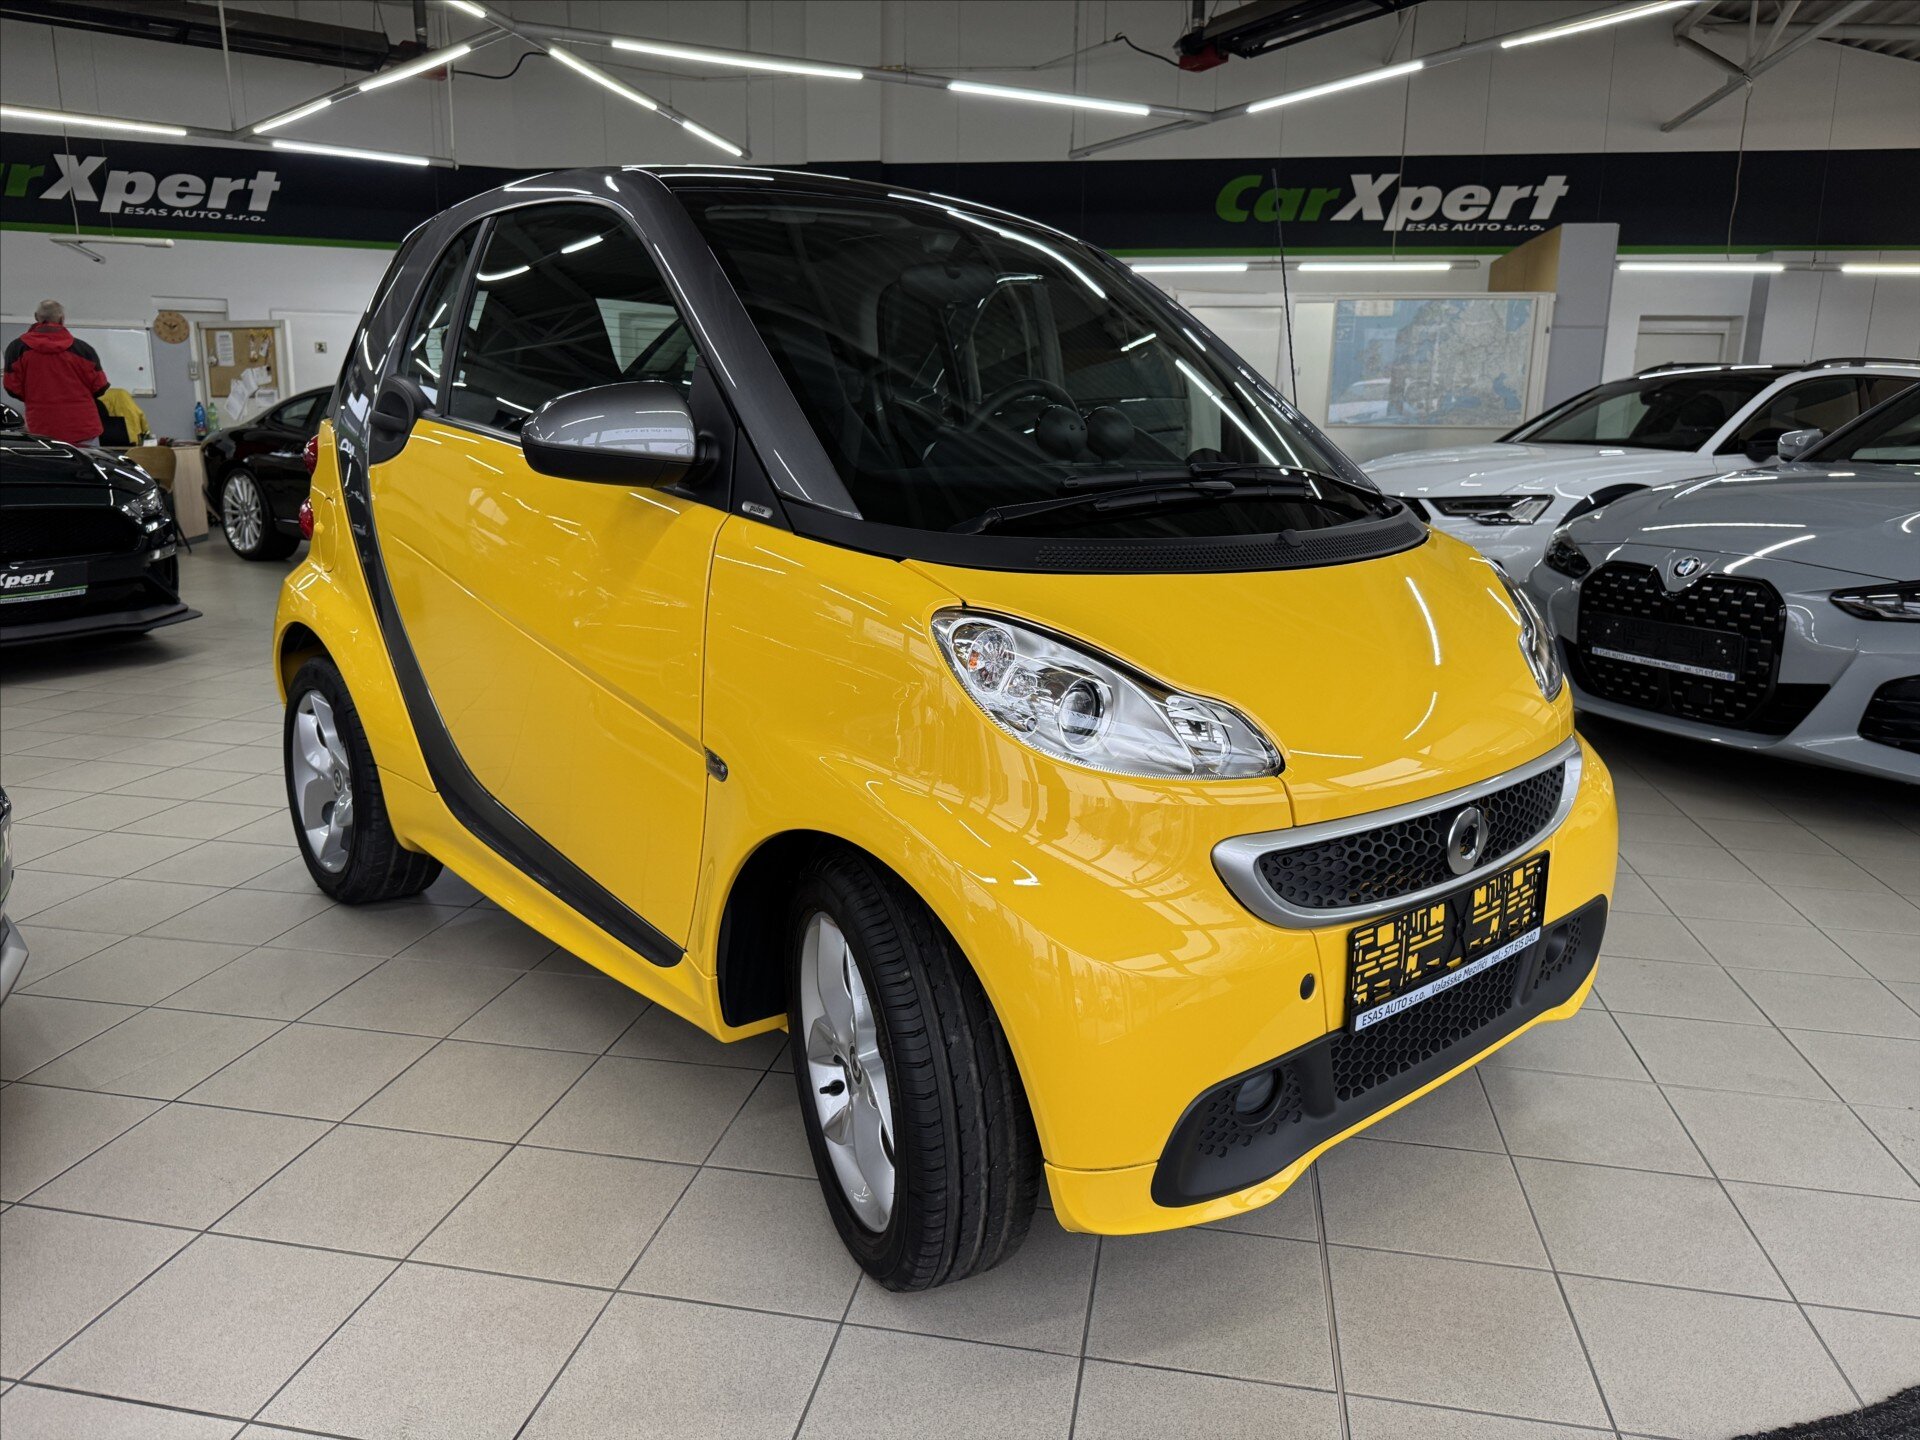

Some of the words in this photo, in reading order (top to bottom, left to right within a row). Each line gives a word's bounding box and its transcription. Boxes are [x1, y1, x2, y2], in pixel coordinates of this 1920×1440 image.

[0, 153, 281, 214] rXpert
[1215, 172, 1570, 231] CarXpert
[123, 205, 169, 218] ESAS
[171, 208, 222, 220] AUTO
[224, 212, 266, 222] s.r.o.
[1406, 222, 1449, 232] ESAS
[1452, 222, 1501, 232] AUTO
[1503, 222, 1546, 232] s.r.o.
[748, 505, 766, 515] pulse
[1362, 1007, 1384, 1026] ESAS
[1384, 997, 1408, 1016] AUTO
[1408, 992, 1426, 1006] s.r.o.
[1503, 945, 1515, 958] 571
[1514, 940, 1524, 952] 615
[1524, 931, 1537, 946] 040
